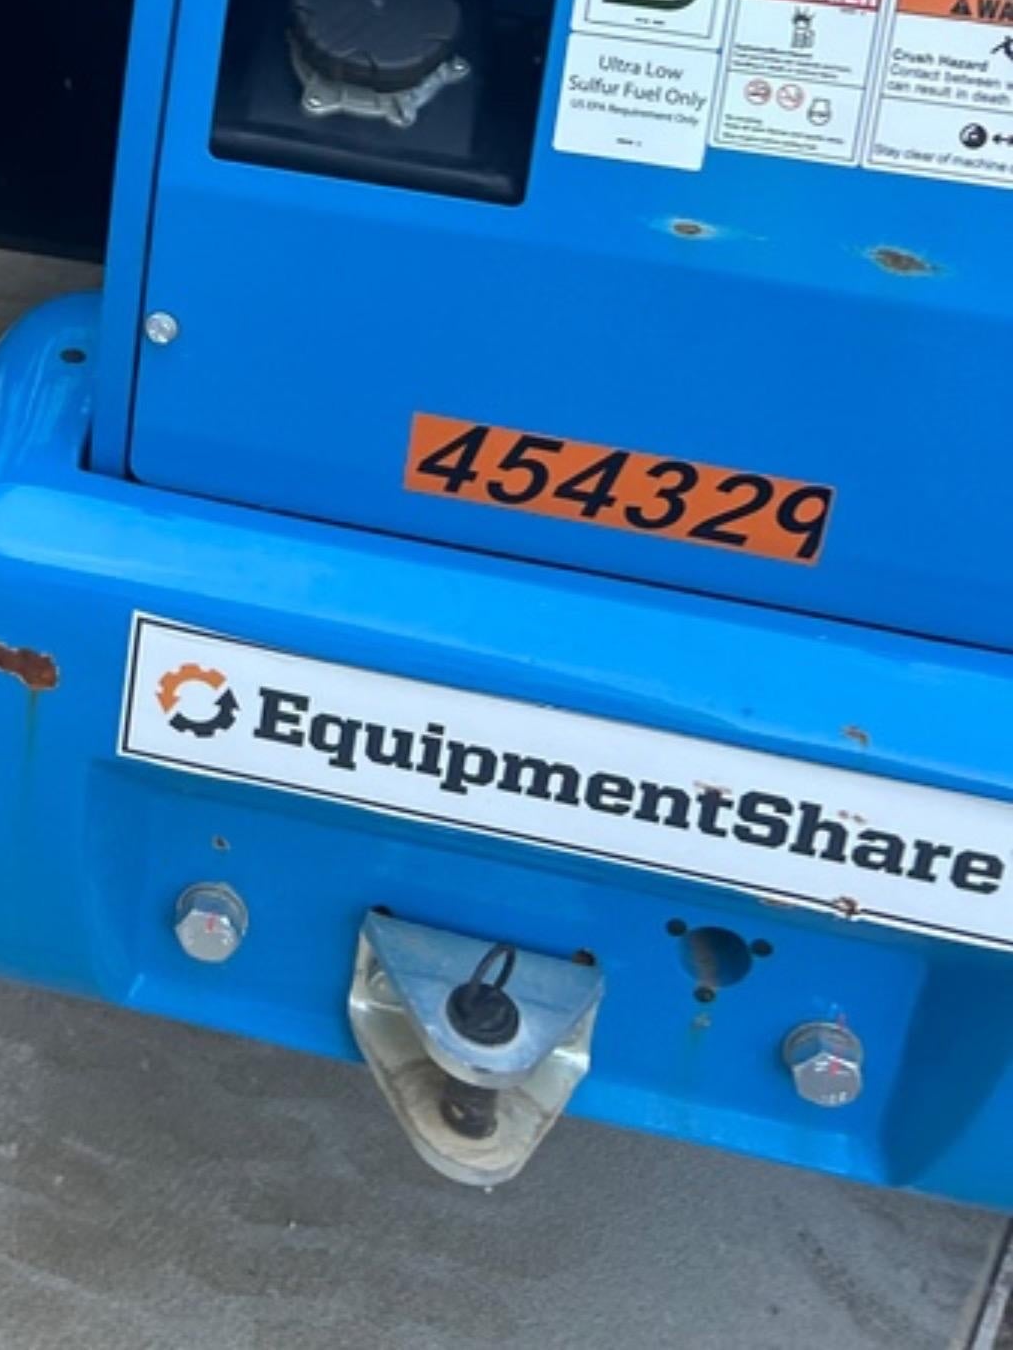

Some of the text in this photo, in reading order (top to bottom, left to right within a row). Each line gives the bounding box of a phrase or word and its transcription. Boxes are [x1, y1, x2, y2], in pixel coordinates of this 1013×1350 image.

[598, 54, 684, 80] Ultra Low
[892, 48, 988, 72] Crush Hazard
[890, 63, 941, 82] Contact
[945, 71, 1001, 88] between
[568, 75, 708, 112] Sulfur Fuel Only
[888, 81, 1010, 105] can result in death
[417, 425, 833, 559] 454329
[253, 686, 1006, 895] EquipmentShare
